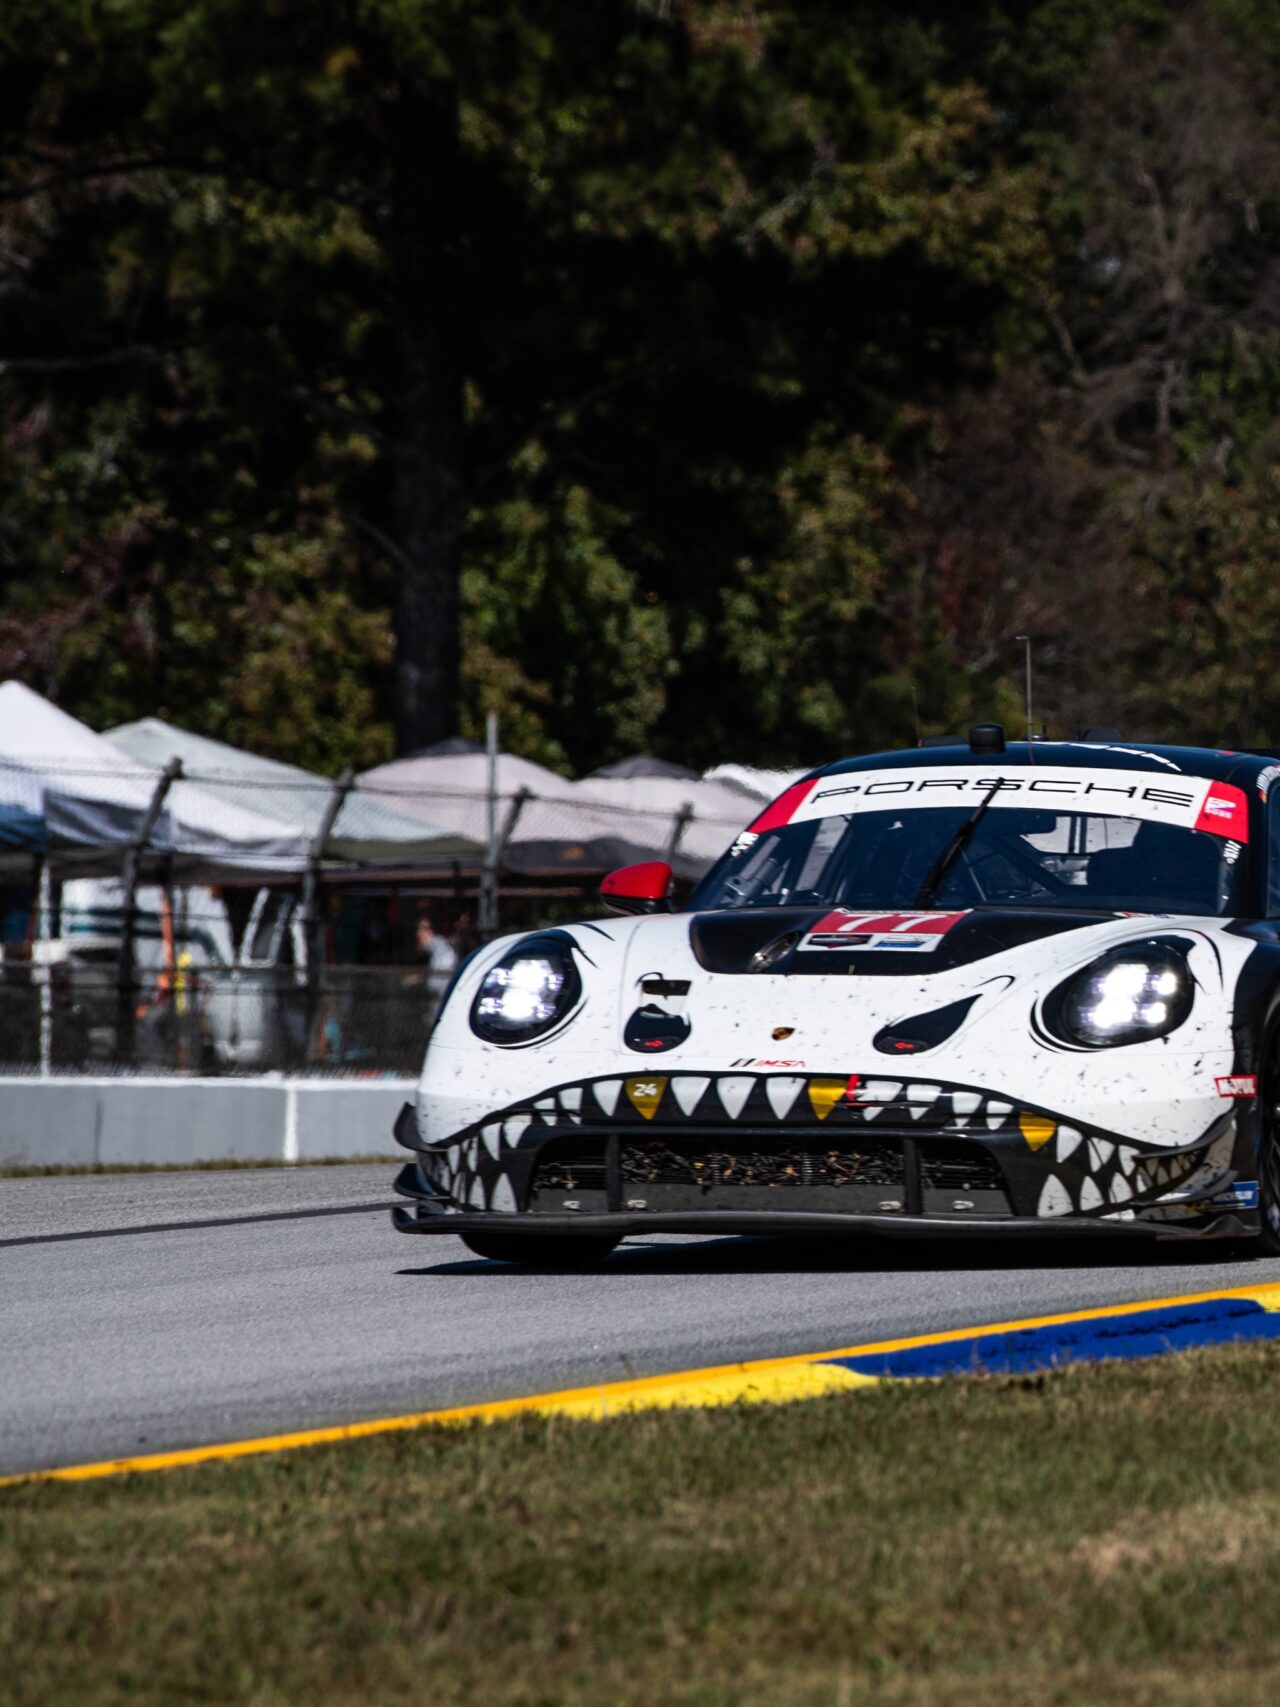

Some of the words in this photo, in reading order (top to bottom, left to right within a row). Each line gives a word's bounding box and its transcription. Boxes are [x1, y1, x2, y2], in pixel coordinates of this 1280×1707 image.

[810, 777, 1195, 808] PORSCHE
[836, 914, 948, 932] 77
[753, 1059, 806, 1068] IMSA
